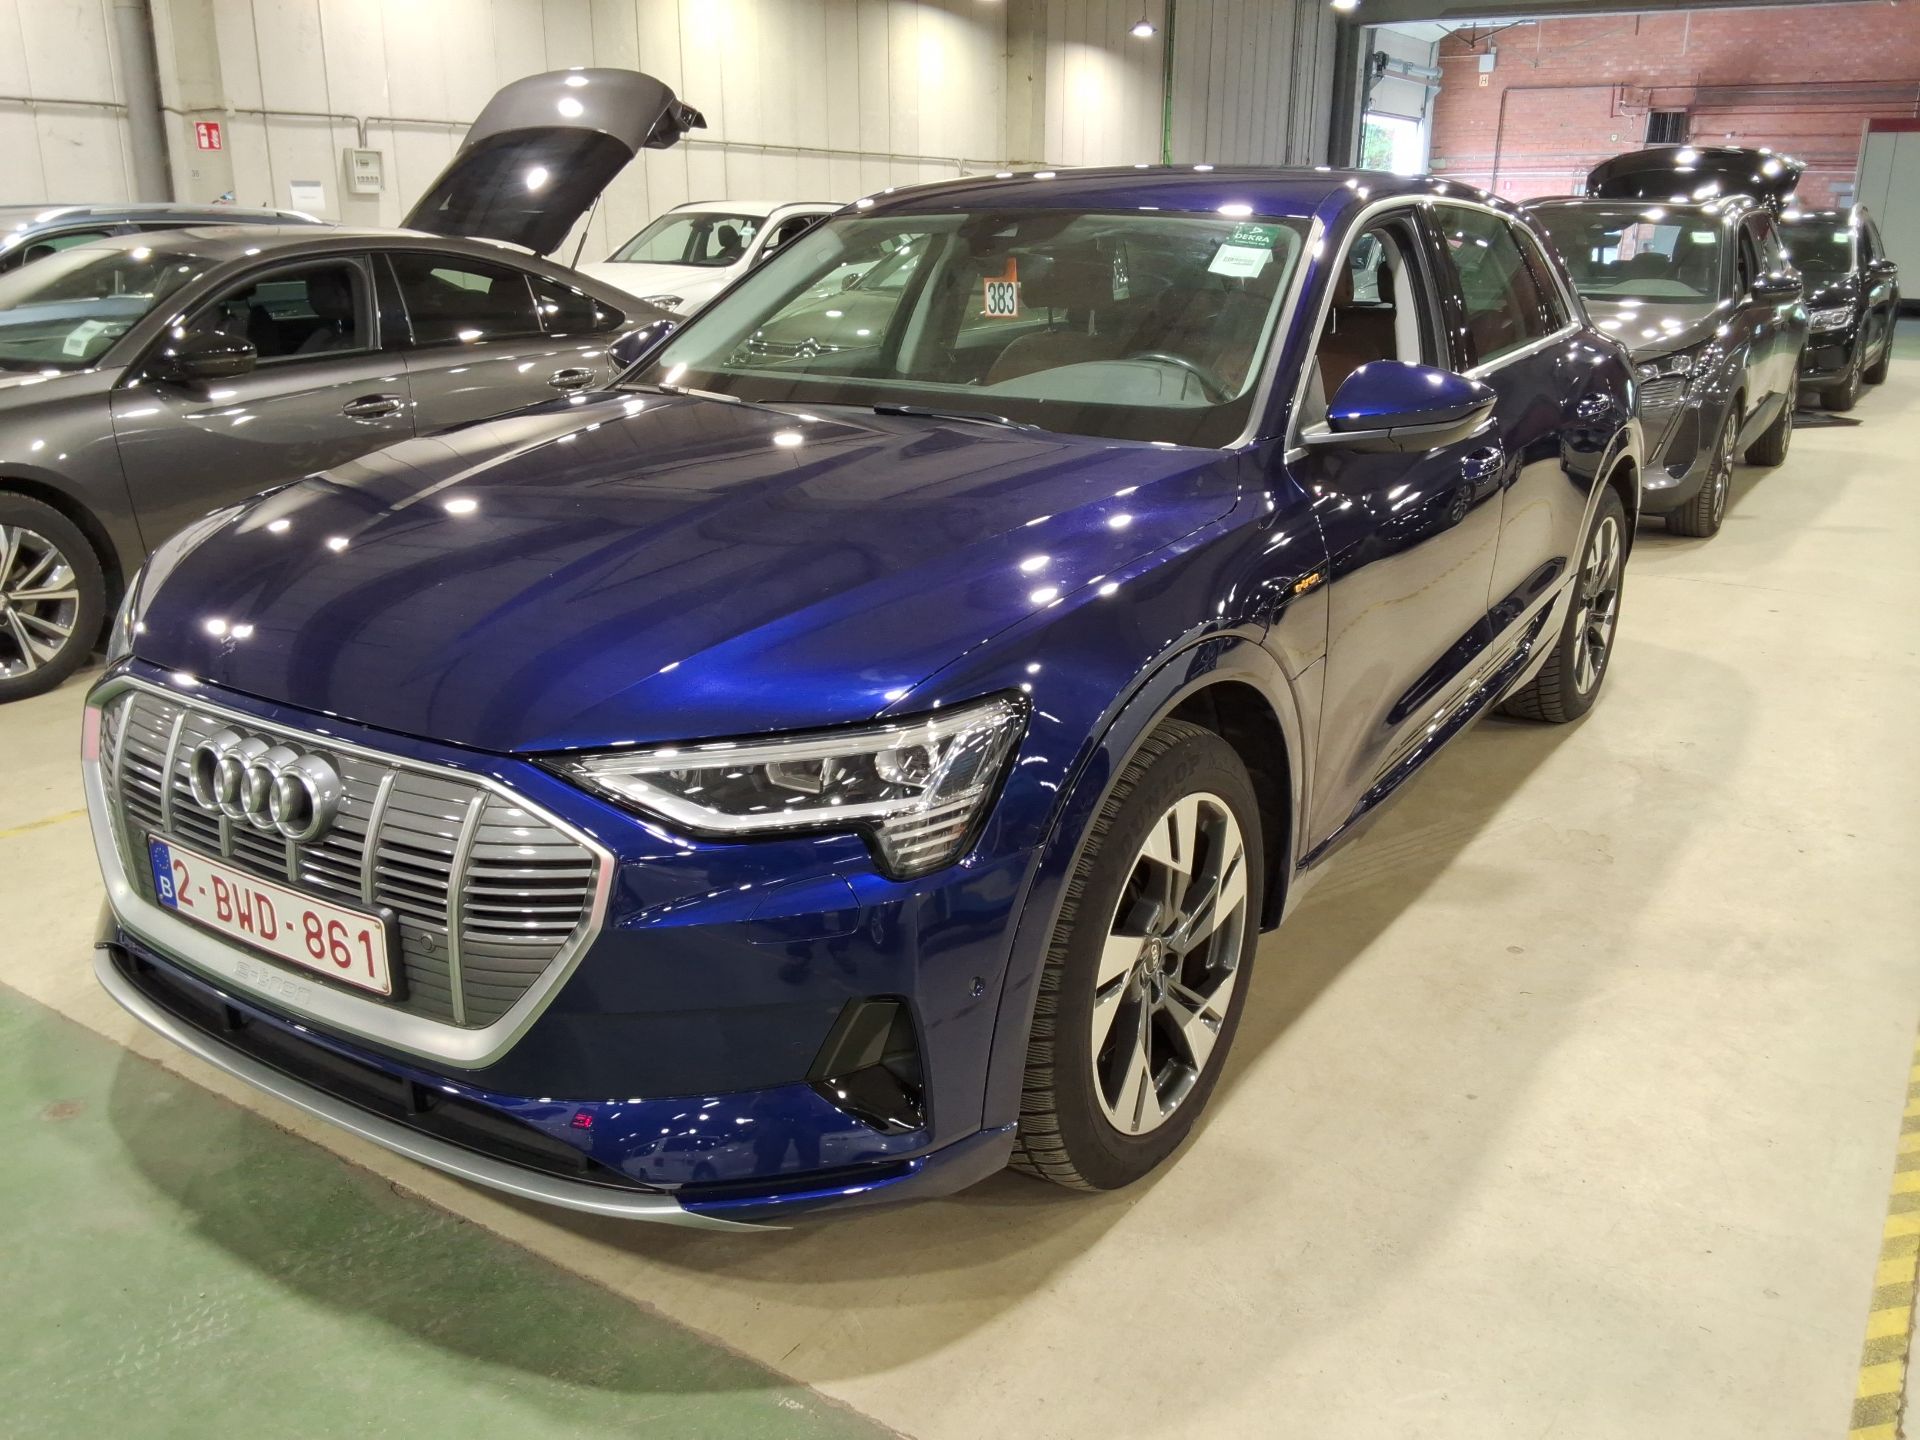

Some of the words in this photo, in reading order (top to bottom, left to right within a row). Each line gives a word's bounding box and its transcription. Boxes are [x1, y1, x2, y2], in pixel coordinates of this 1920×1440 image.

[1235, 233, 1270, 243] DEKRA
[988, 282, 1015, 314] 383
[159, 875, 174, 899] B
[173, 858, 376, 978] 2-BWD-861
[234, 960, 312, 1003] e-tron
